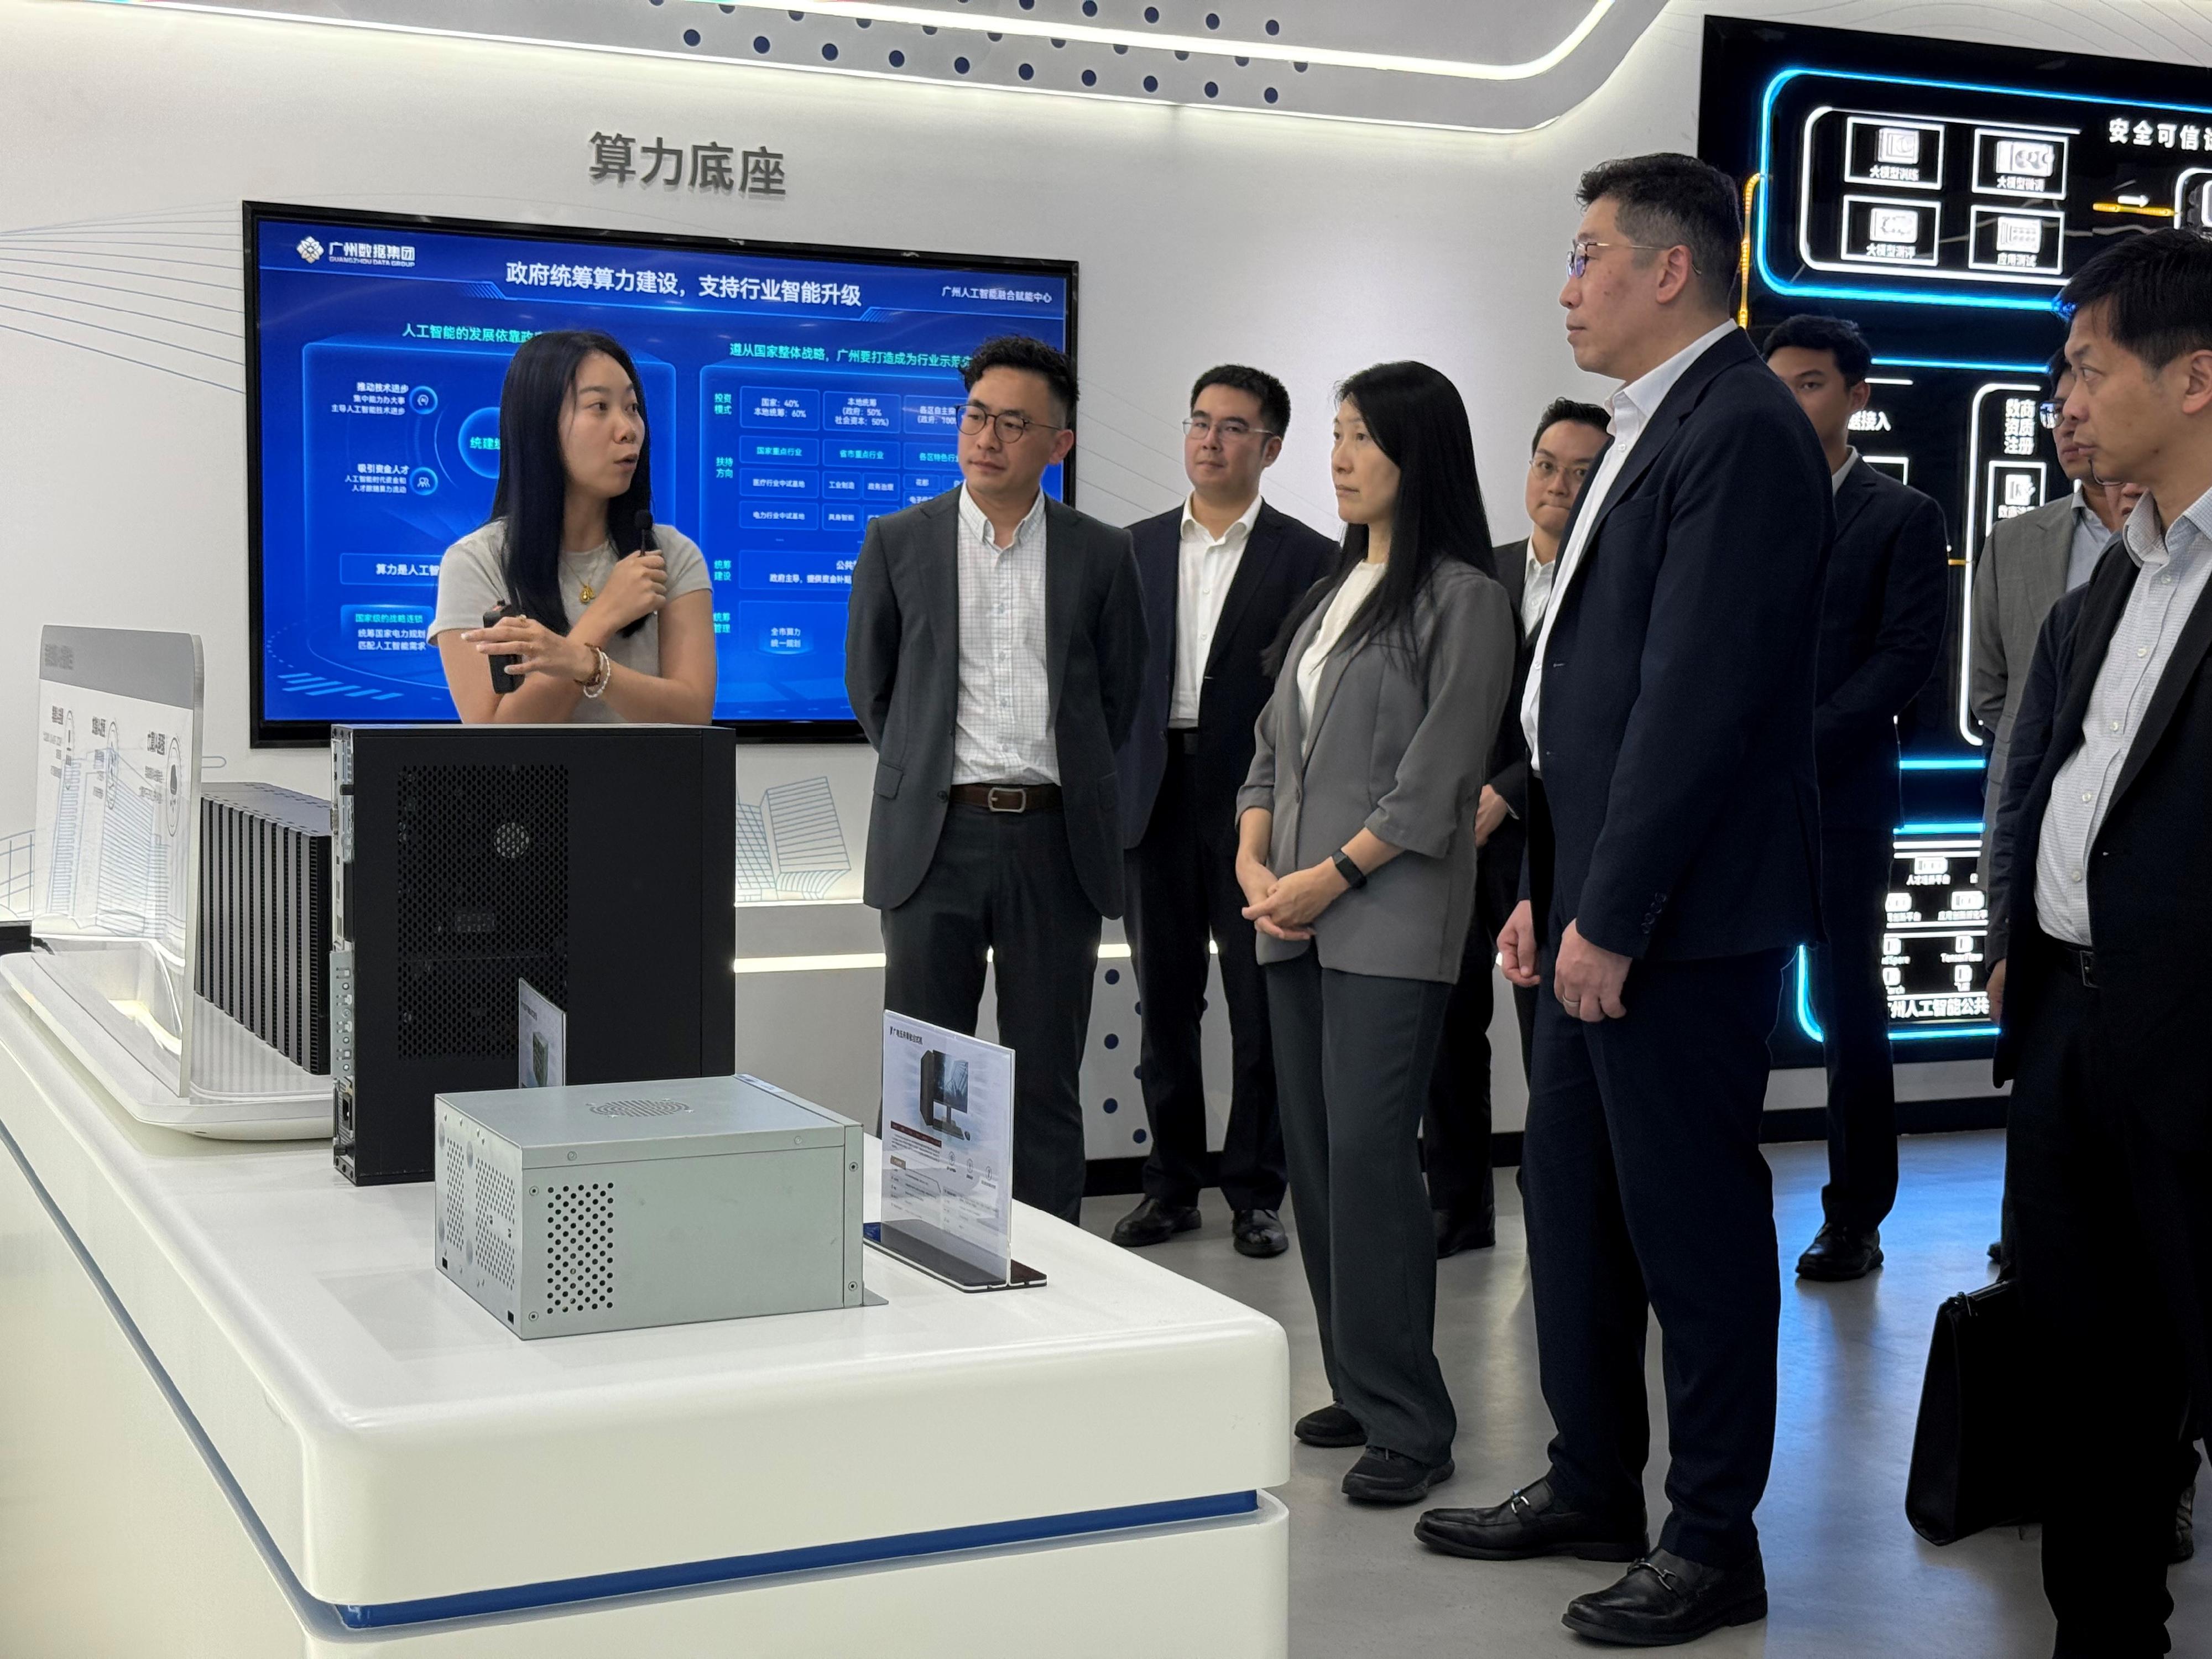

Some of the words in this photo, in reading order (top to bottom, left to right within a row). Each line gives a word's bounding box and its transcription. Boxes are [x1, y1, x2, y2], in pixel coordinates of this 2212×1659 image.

[588, 131, 786, 196] 算力底座
[1870, 165, 1919, 181] 大模型训练
[328, 242, 415, 261] 广州数据集团
[329, 256, 372, 264] GUANGZHOU
[505, 261, 862, 306] 政府统筹算力建设，支持行业智能升级
[942, 286, 1053, 303] 广州人工智能融合赋能中心
[402, 323, 543, 344] 人工智能的发展依靠政
[357, 382, 409, 394] 推动技术进步
[714, 404, 732, 415] 模式
[756, 446, 802, 456] 国家重点行业
[840, 449, 884, 460] 省市重点行业
[716, 468, 733, 478] 方向
[753, 478, 805, 488] 医疗行业中试基地
[828, 481, 855, 490] 工业制造
[753, 511, 805, 520] 电力行业中试基地
[376, 564, 440, 576] 算力是人工智
[714, 560, 732, 570] 统筹
[836, 560, 857, 570] 公共
[714, 571, 731, 581] 建设
[358, 640, 426, 651] 匹配人工智能需求
[1887, 997, 1990, 1019] 州人工智能公共
